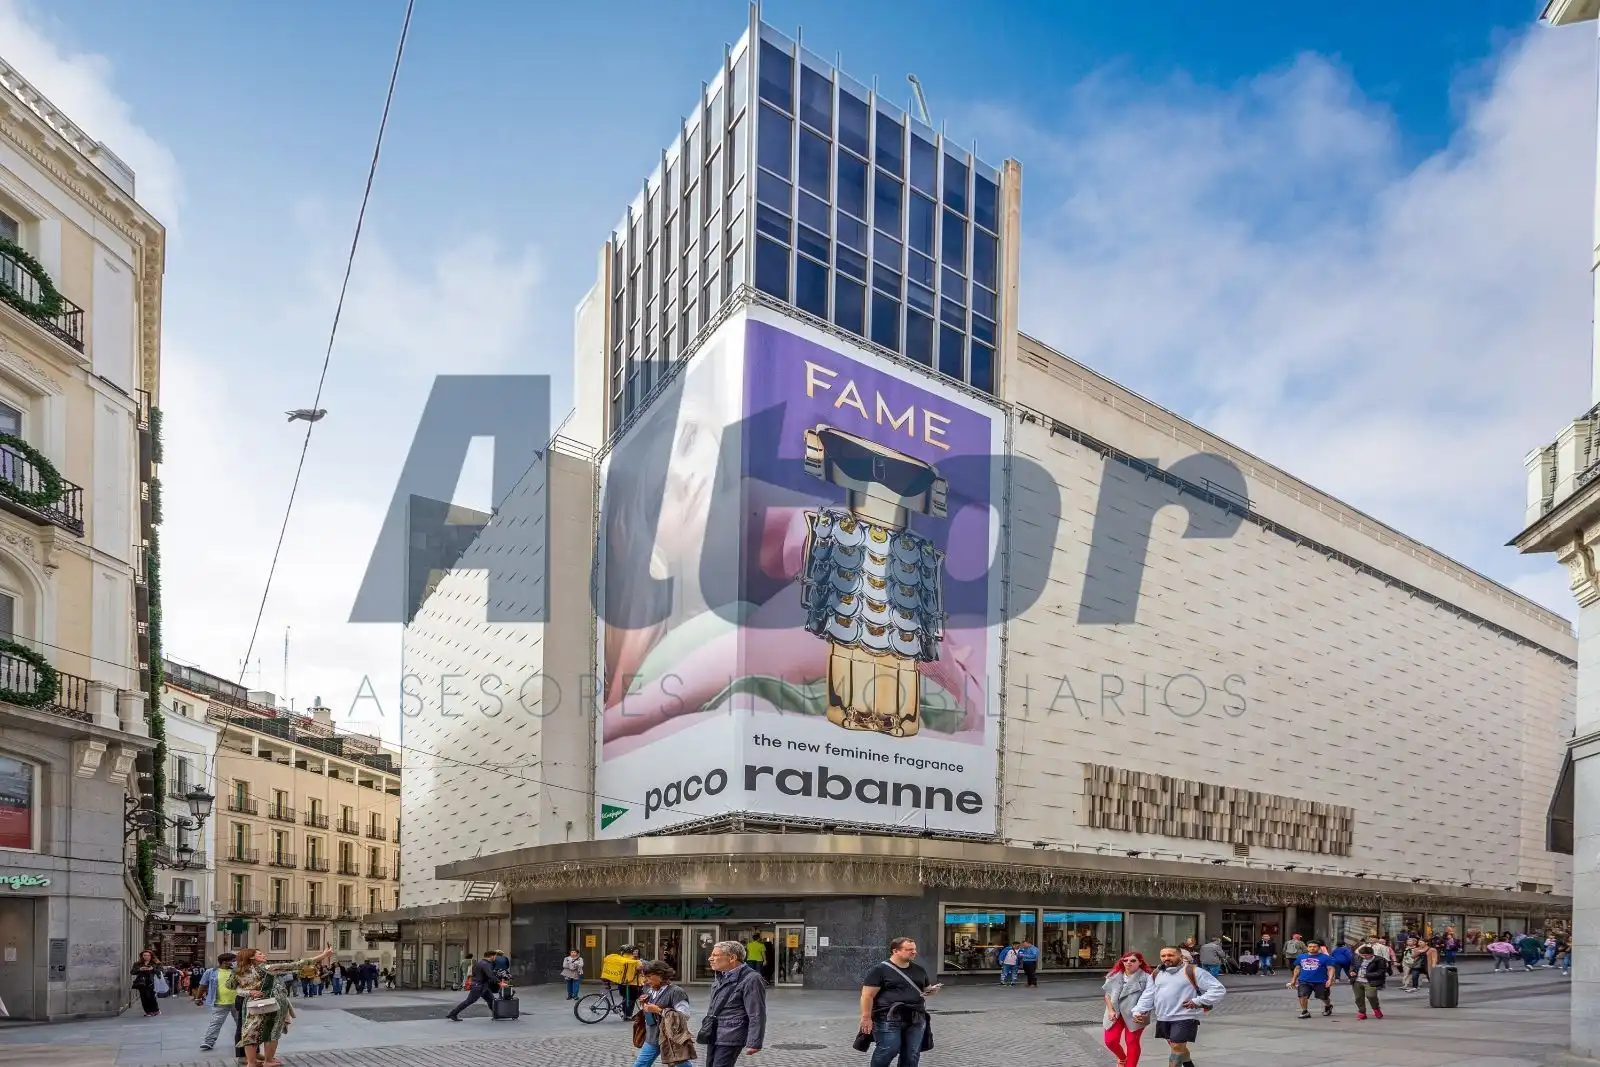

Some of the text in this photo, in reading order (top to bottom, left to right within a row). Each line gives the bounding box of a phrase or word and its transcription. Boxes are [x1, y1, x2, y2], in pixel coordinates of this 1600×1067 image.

[804, 360, 952, 451] FAME
[752, 733, 964, 773] the new feminine fragrance
[644, 765, 983, 819] paco rabanne
[0, 874, 50, 890] nglés
